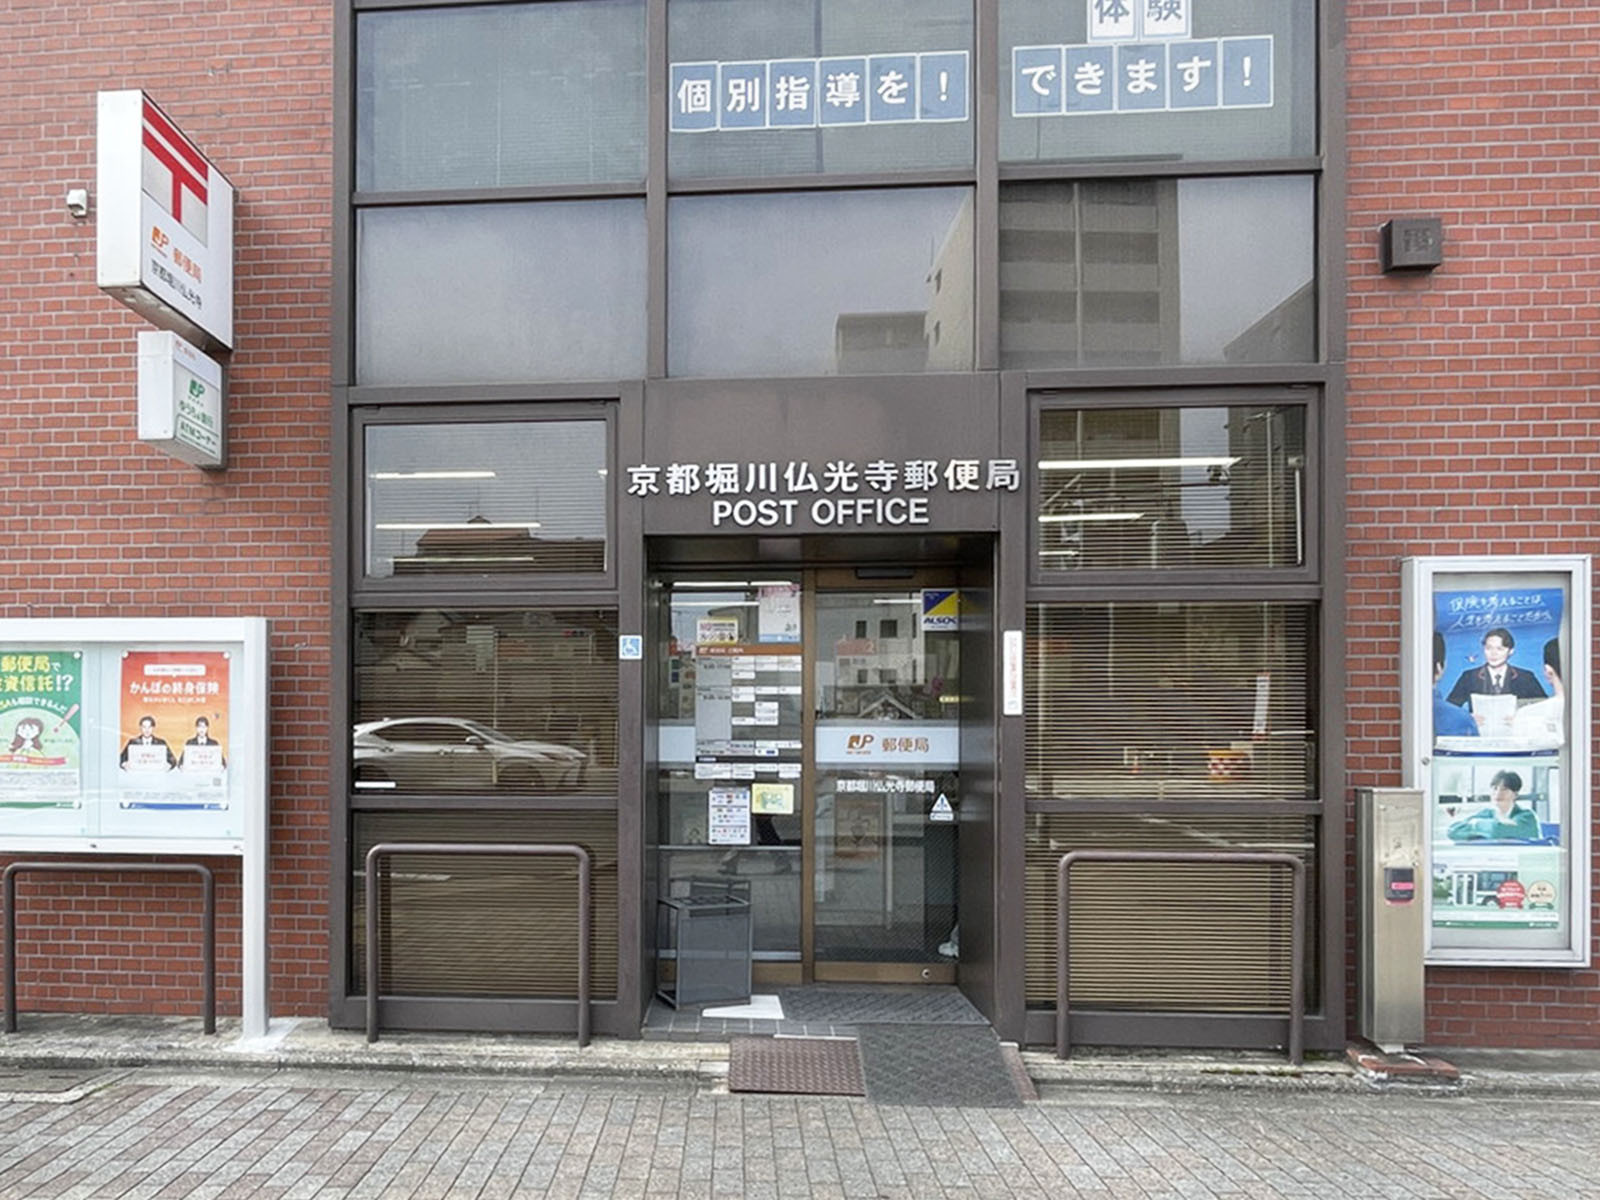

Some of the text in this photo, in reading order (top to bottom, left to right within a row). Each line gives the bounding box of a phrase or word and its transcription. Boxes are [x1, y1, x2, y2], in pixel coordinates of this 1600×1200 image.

[1022, 56, 1253, 96] できます!
[677, 71, 949, 114] 個別指導を!
[626, 459, 1021, 496] 京都堀川仏光寺郵便局
[712, 498, 930, 527] POST OFFICE
[923, 617, 957, 625] ALSOK
[1, 654, 61, 673] 郵便局で
[0, 674, 74, 692] 資信託!?
[882, 737, 930, 753] 郵便局
